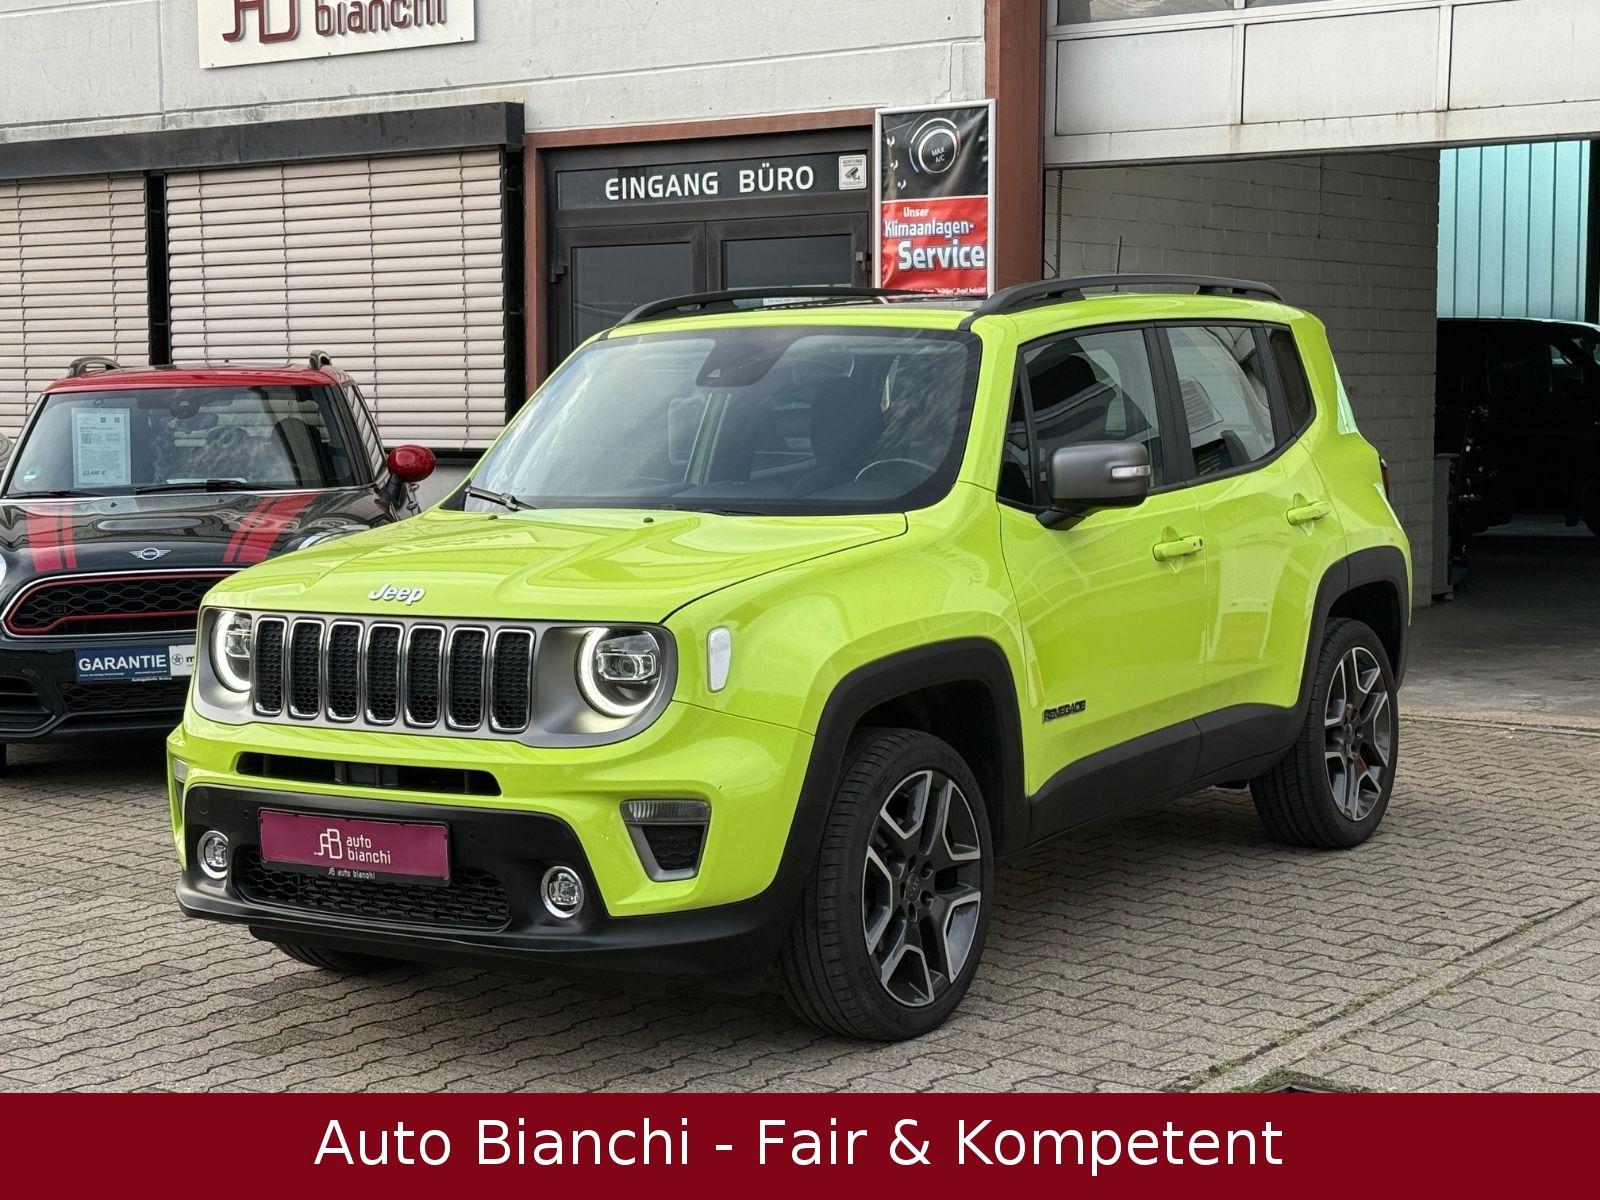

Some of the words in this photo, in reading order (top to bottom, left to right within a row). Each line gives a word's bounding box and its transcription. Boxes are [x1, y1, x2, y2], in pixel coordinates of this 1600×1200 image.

[605, 171, 719, 200] EINGANG
[739, 162, 814, 193] BÜRO
[903, 206, 929, 217] Unser
[884, 218, 974, 238] Klimaanlagen-
[898, 239, 985, 270] Service
[368, 583, 426, 606] Jeep
[79, 655, 167, 671] GARANTIE
[1042, 700, 1086, 724] RENEGADE
[346, 834, 372, 849] auto
[348, 847, 391, 864] bianchi
